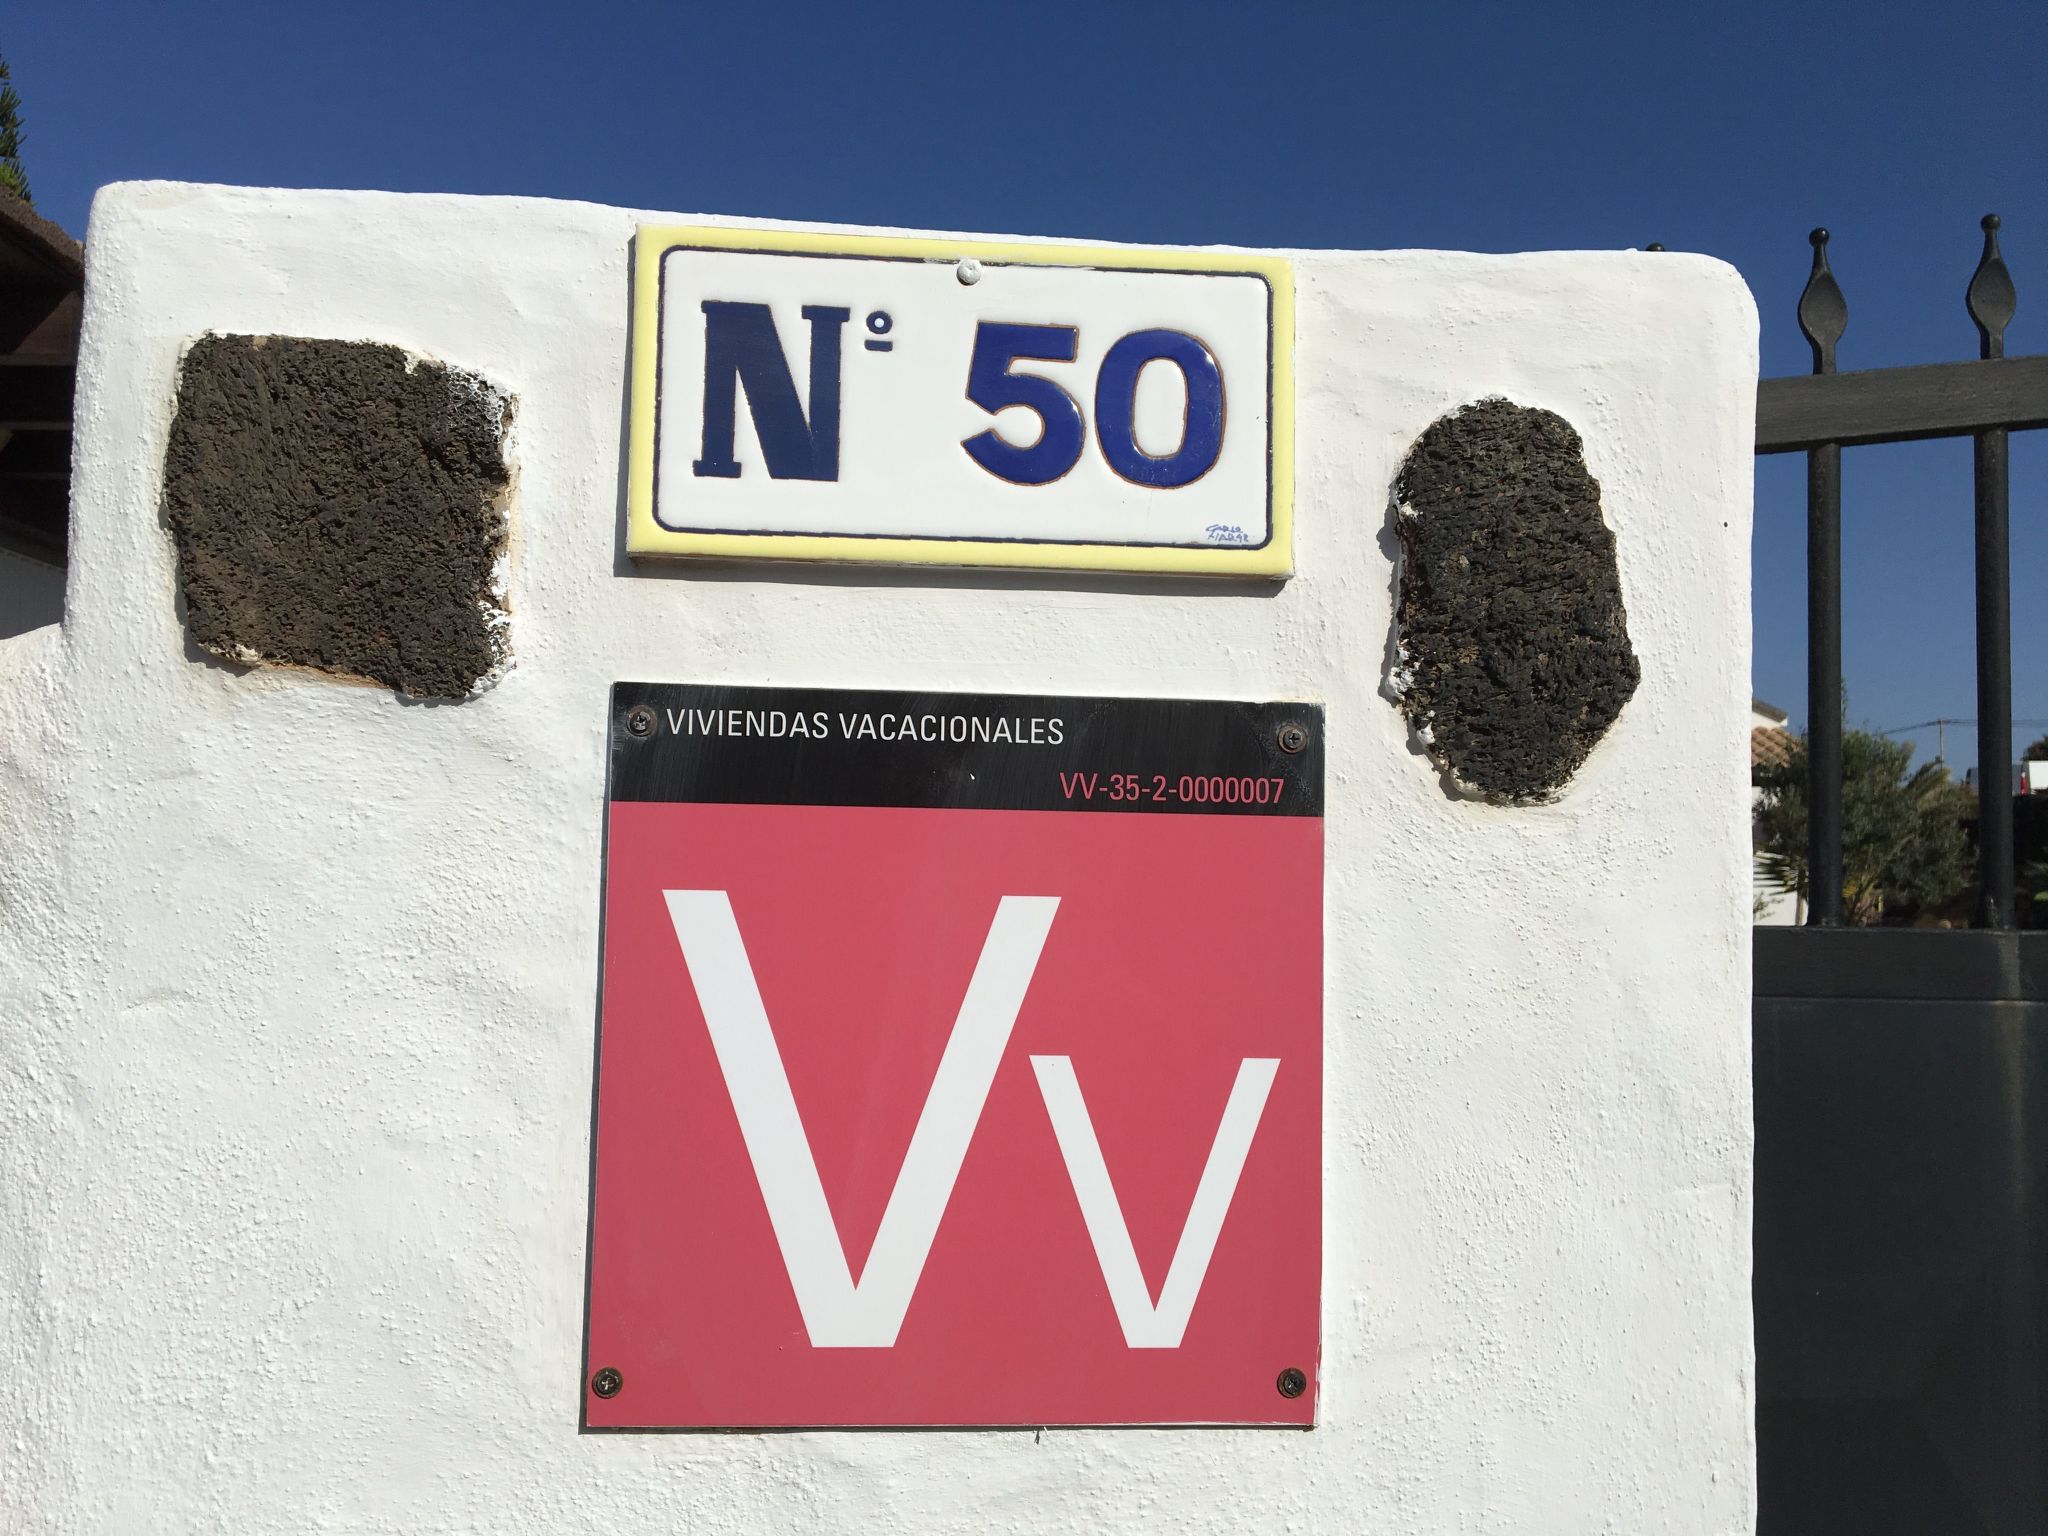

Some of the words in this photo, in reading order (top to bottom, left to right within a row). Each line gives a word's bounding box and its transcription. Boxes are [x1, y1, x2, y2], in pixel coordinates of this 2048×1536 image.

[960, 320, 1227, 489] 50
[666, 708, 829, 740] VIVIENDAS
[839, 713, 1065, 746] VACACIONALES
[1059, 773, 1284, 804] VV-35-2-0000007
